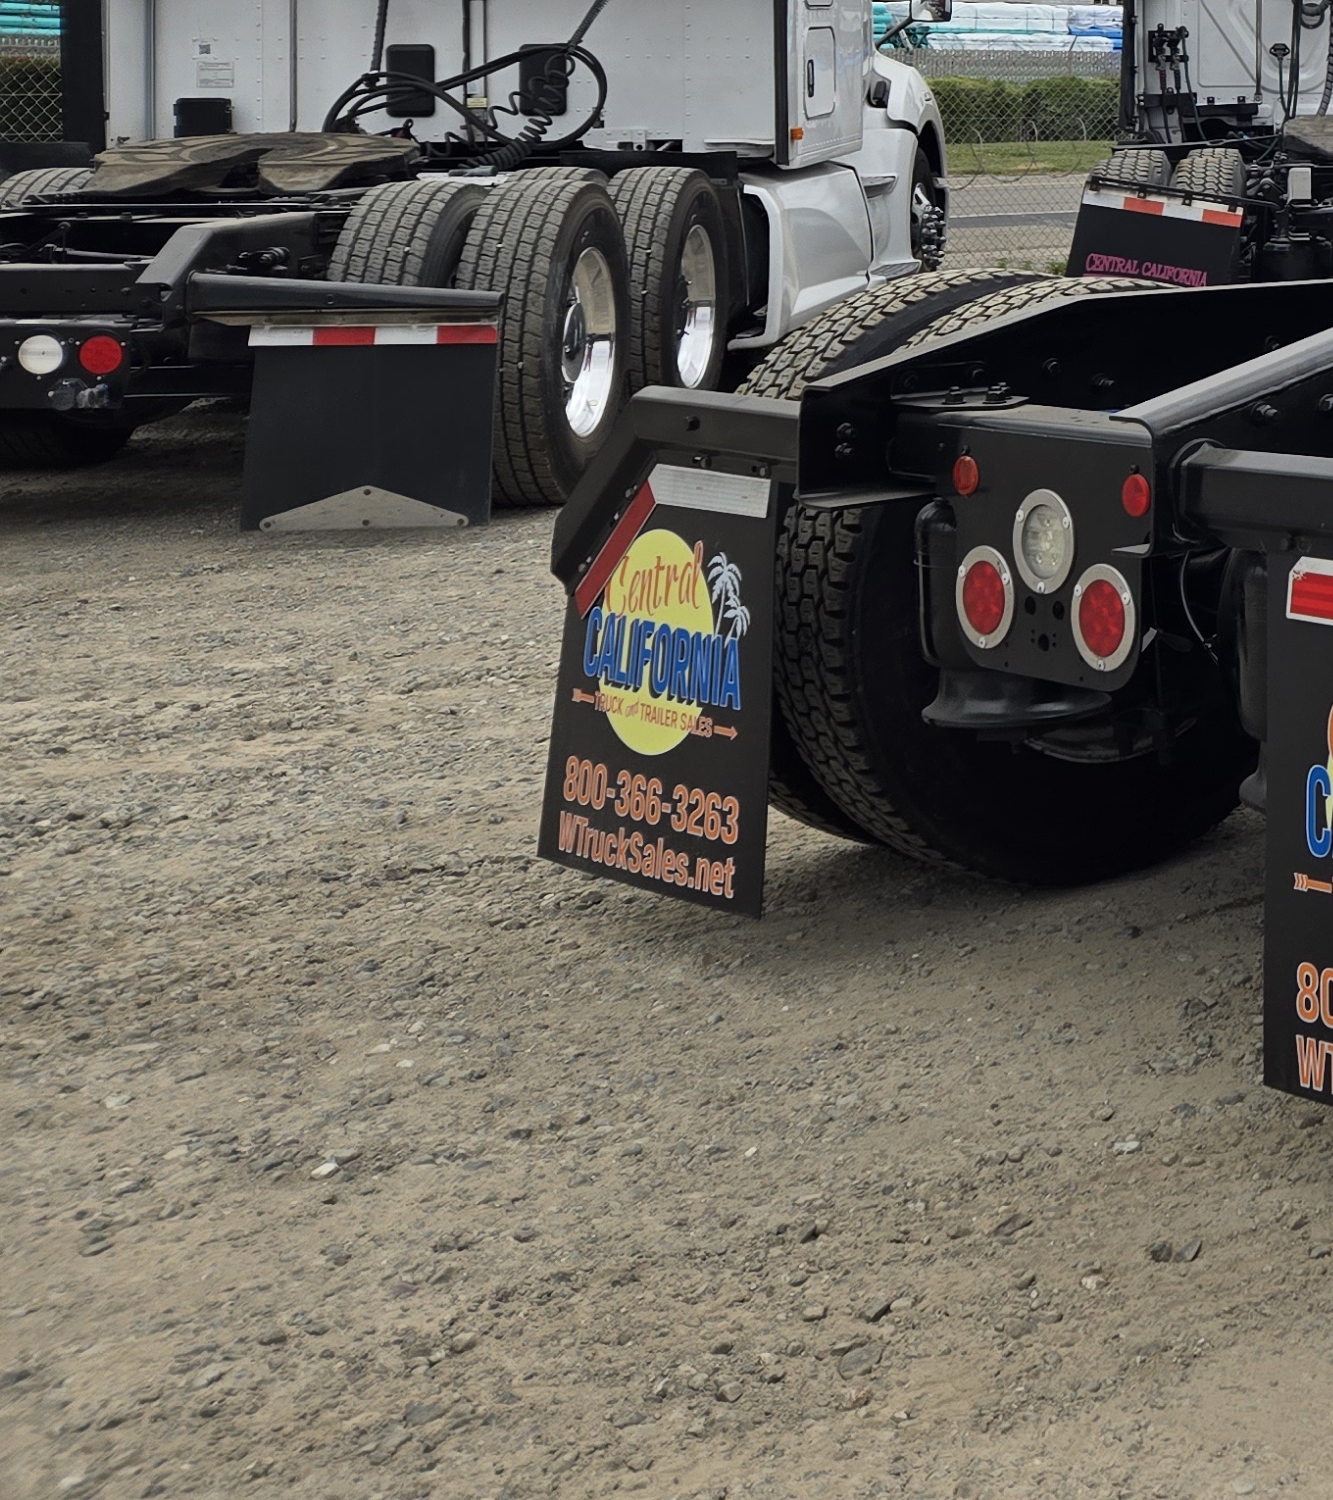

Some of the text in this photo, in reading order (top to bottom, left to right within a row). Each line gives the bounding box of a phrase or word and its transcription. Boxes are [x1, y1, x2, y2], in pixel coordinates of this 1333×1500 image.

[1086, 252, 1208, 288] CENTRAL CALIFORNIA
[604, 541, 705, 620] Central
[582, 606, 742, 711] CALIFORNIA
[594, 690, 624, 716] TRUCK
[639, 702, 678, 730] TRAILER
[680, 712, 713, 738] SALES
[562, 754, 740, 845] 800-366-3263
[557, 809, 735, 899] WTruckSales.net
